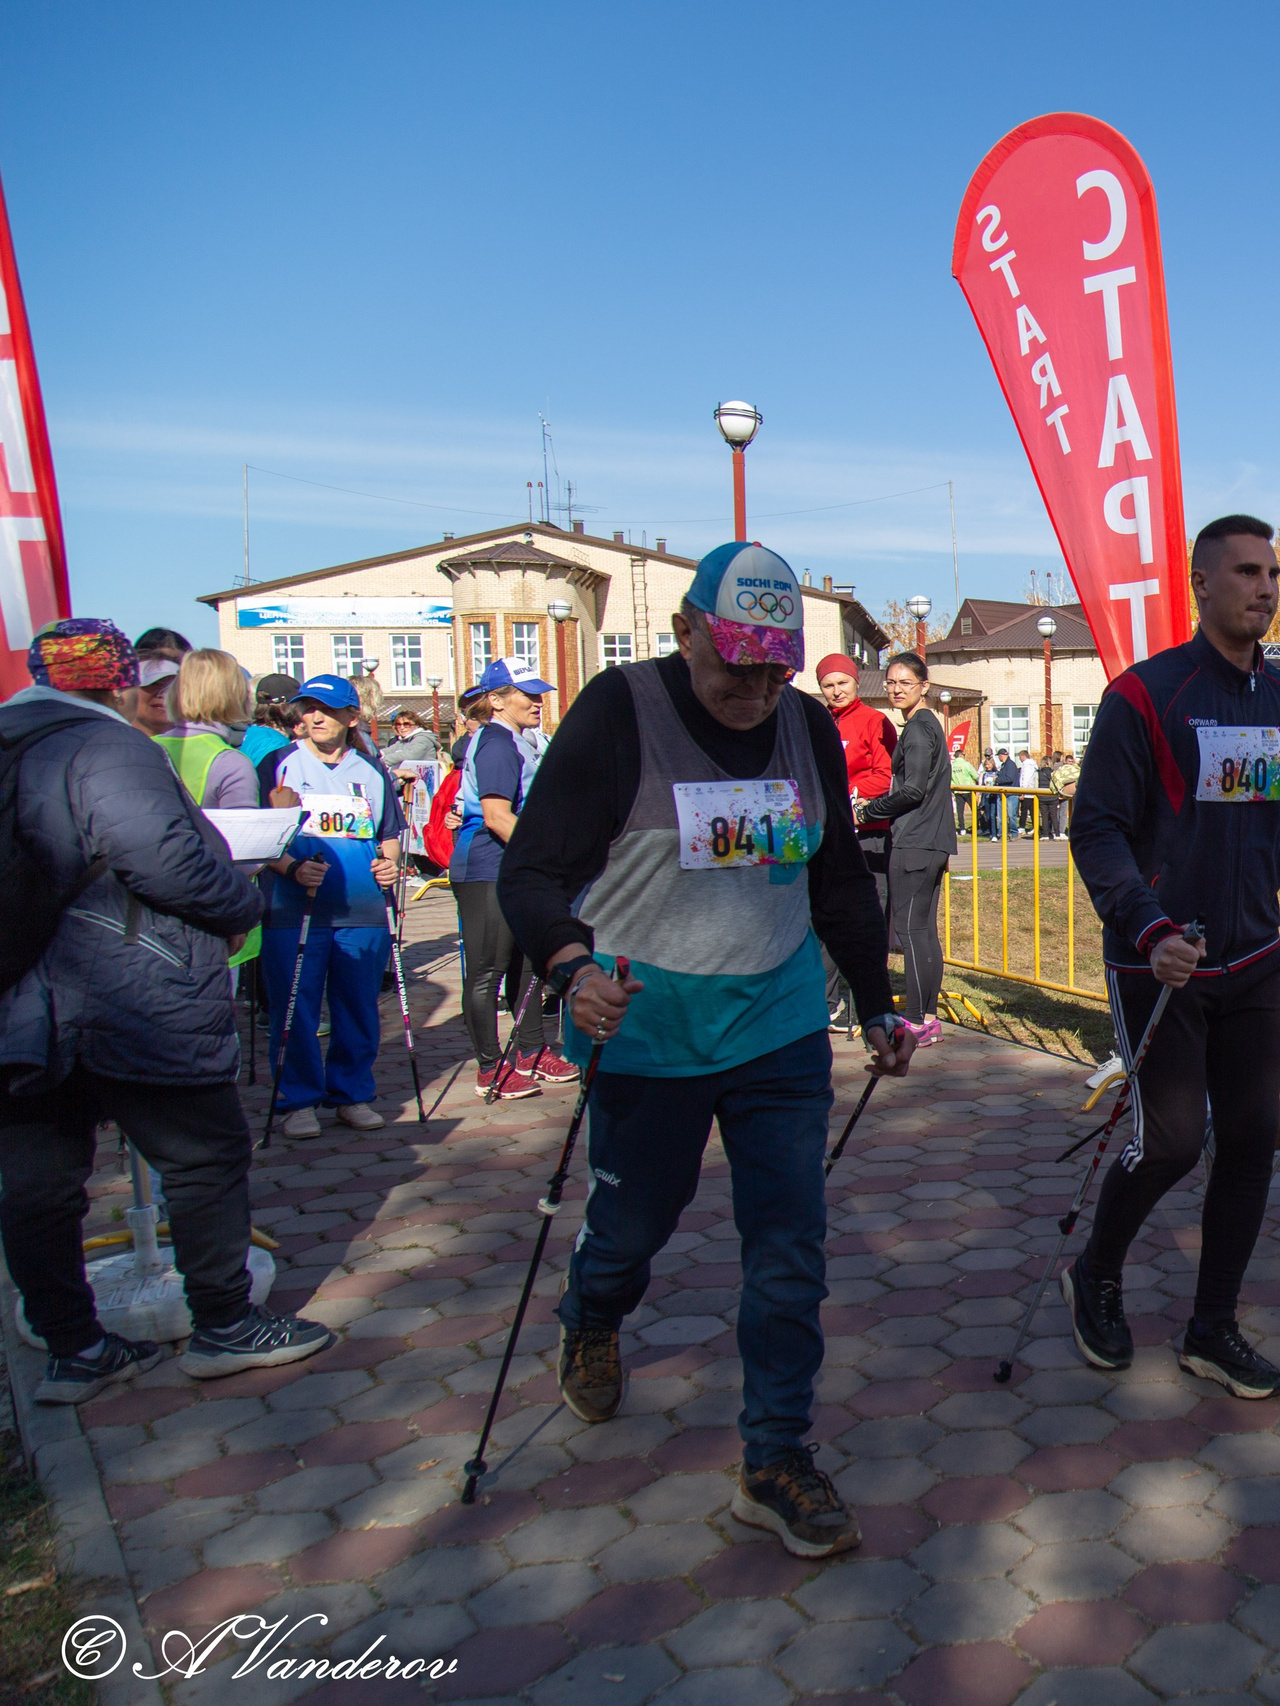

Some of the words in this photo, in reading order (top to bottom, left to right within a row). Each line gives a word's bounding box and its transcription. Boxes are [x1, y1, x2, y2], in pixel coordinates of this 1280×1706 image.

[736, 577, 771, 589] SOCHI
[772, 579, 792, 593] 2014
[1221, 757, 1267, 793] 840
[319, 811, 356, 832] 802
[711, 814, 775, 857] 841
